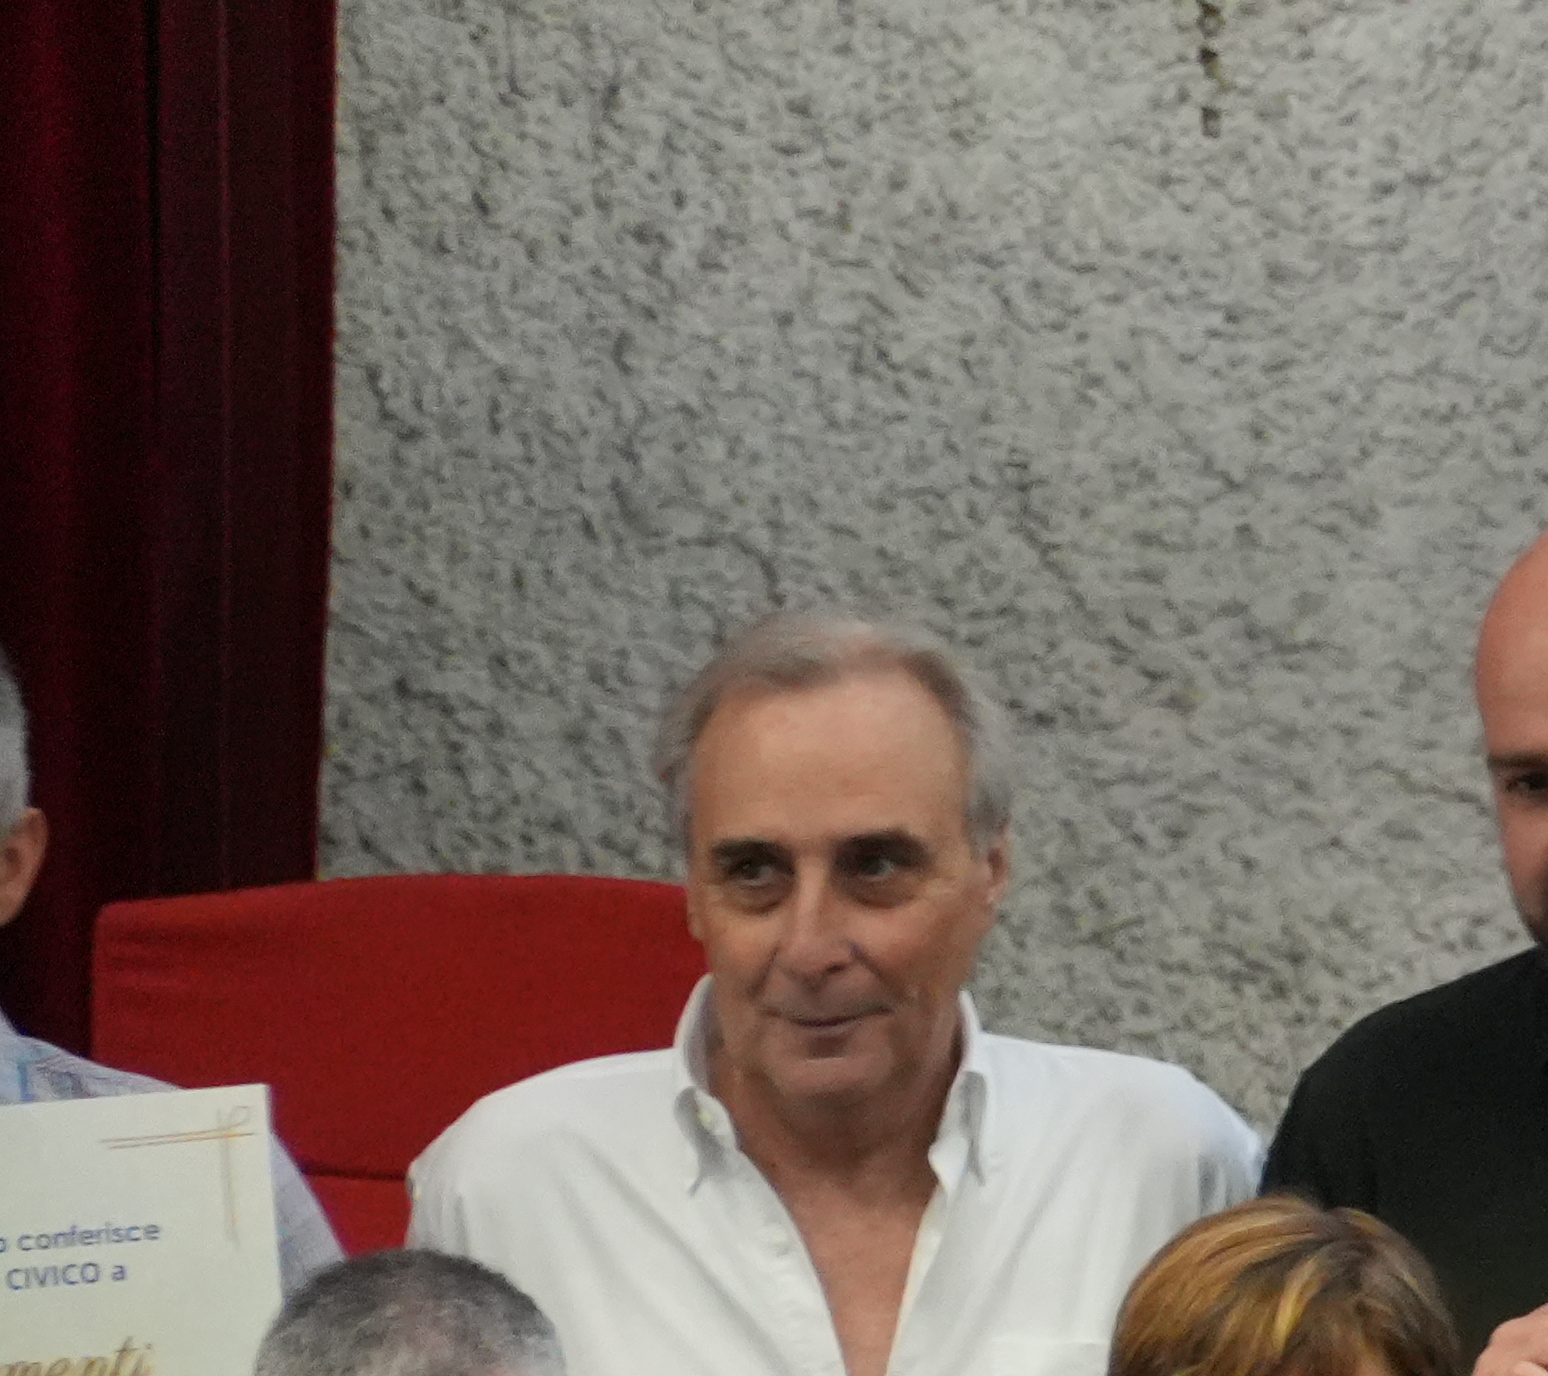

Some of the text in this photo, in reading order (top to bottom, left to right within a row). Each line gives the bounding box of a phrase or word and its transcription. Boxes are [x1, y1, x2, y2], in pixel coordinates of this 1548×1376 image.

[16, 1222, 162, 1252] conferisce
[5, 1262, 127, 1291] CIVICO a
